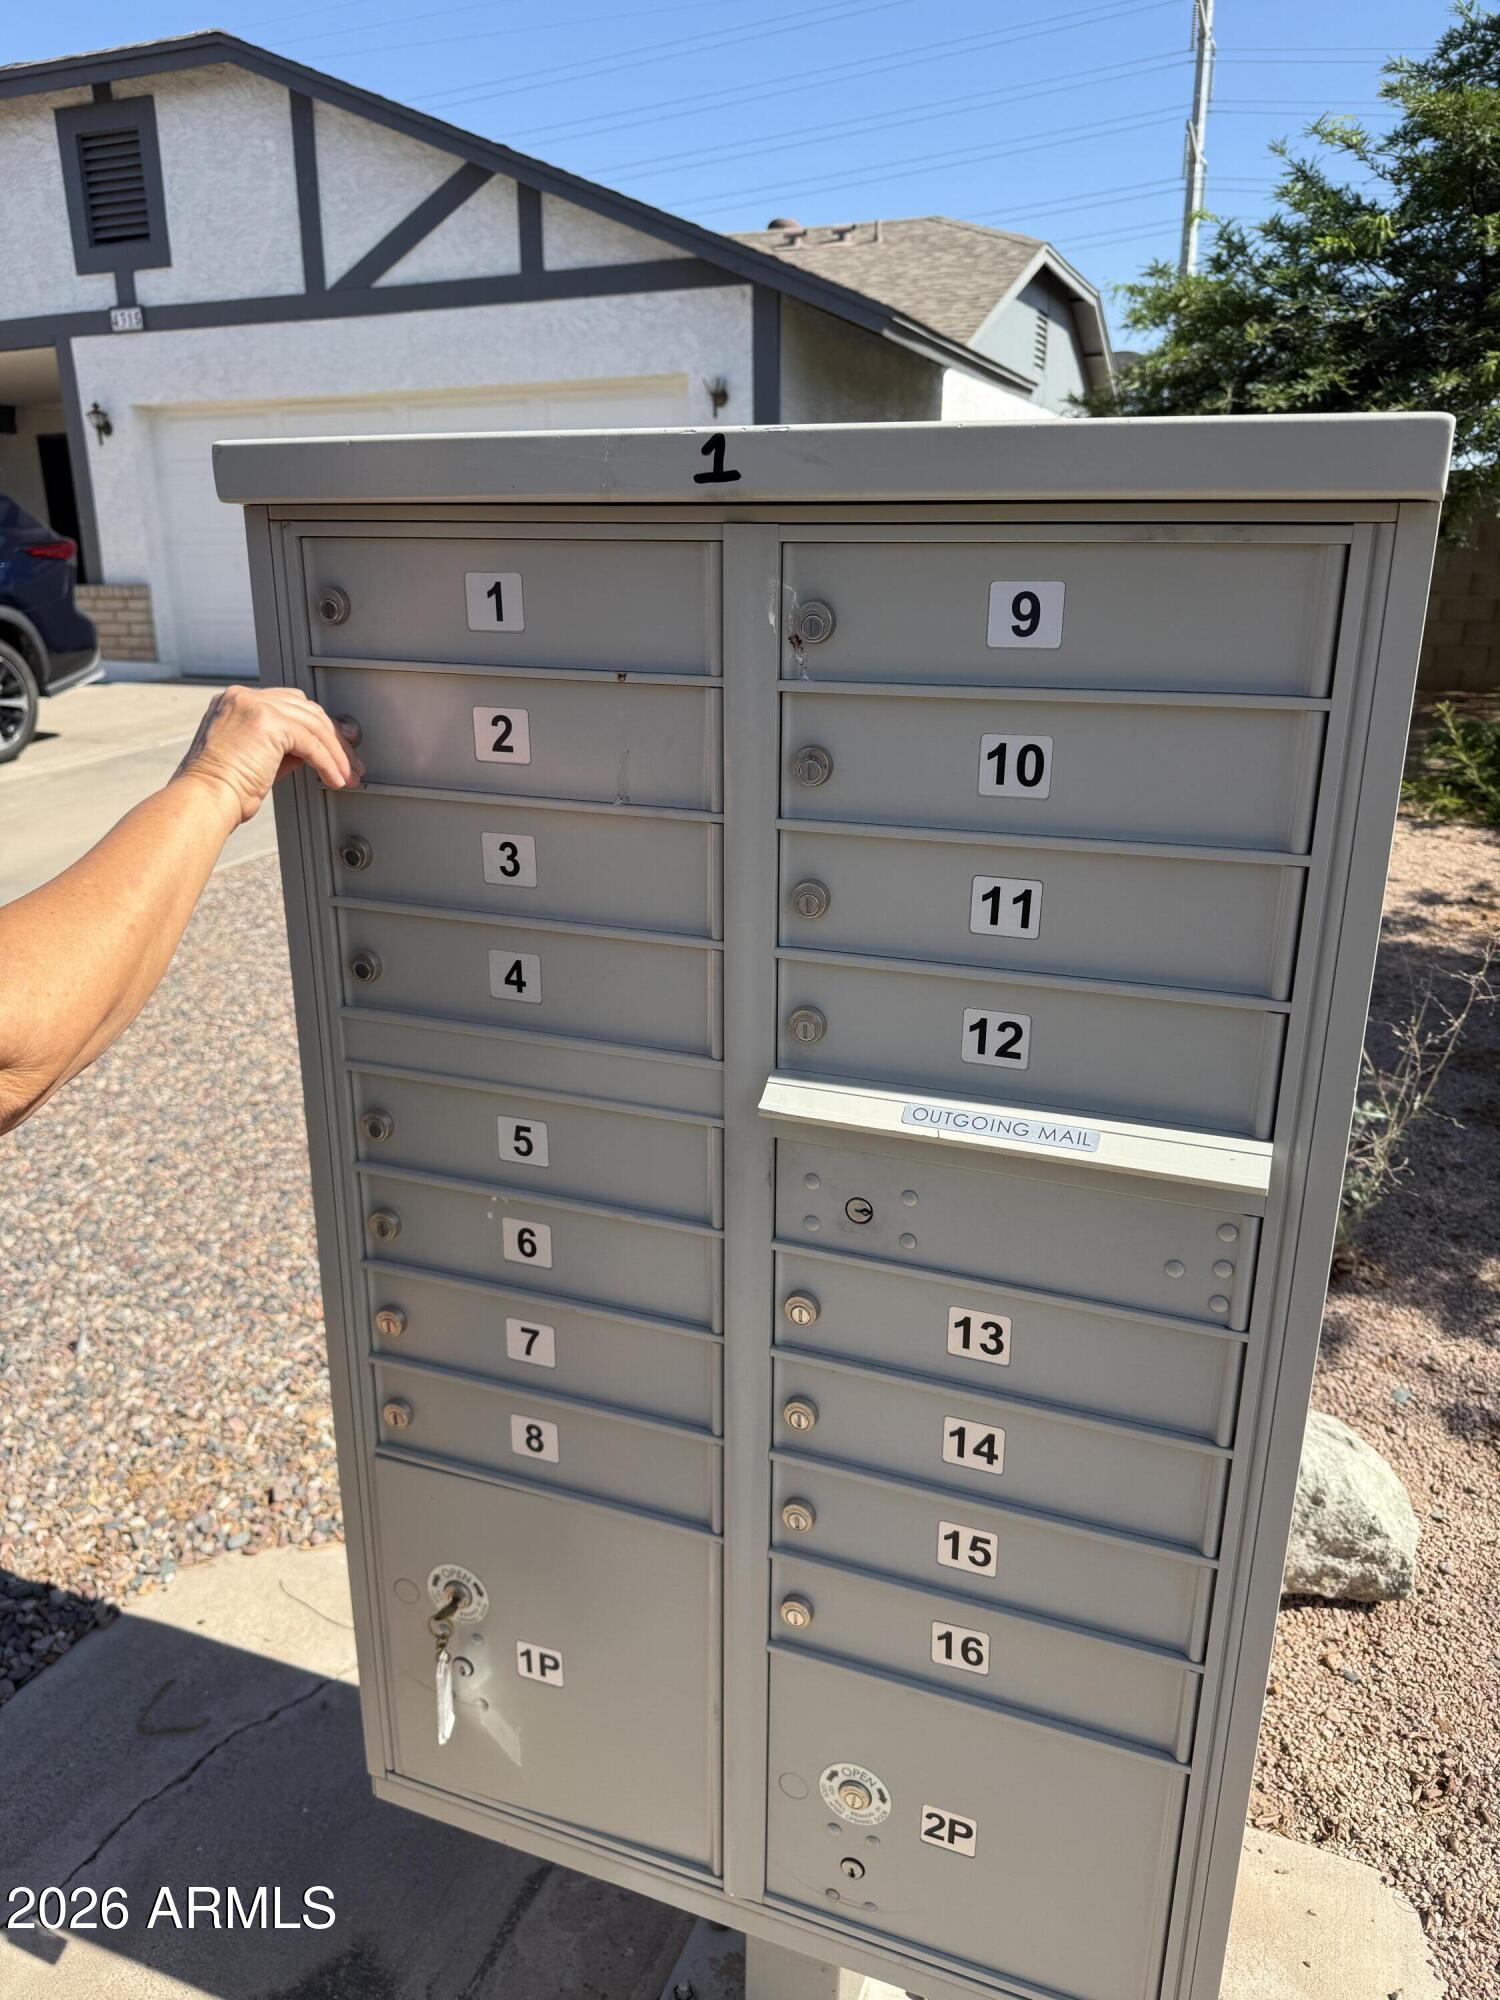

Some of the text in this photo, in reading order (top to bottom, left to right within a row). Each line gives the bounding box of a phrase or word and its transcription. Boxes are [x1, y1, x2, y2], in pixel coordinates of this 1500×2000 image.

[693, 432, 742, 484] 1
[486, 581, 504, 622] 1
[1011, 591, 1040, 637] 9
[491, 715, 514, 752] 2
[986, 742, 1045, 788] 10
[499, 842, 520, 877] 3
[981, 886, 1033, 929] 11
[504, 960, 527, 993] 4
[969, 1017, 1025, 1060] 12
[513, 1125, 534, 1156] 5
[912, 1107, 1091, 1147] OUTGOING MAIL
[518, 1228, 537, 1258] 6
[521, 1327, 540, 1356] 7
[955, 1317, 1005, 1356] 13
[525, 1424, 544, 1453] 8
[949, 1427, 999, 1465] 14
[944, 1530, 992, 1567] 15
[441, 1568, 471, 1583] OPEN
[520, 1648, 560, 1676] 1P
[937, 1631, 984, 1666] 16
[841, 1767, 877, 1787] OPEN
[924, 1812, 973, 1845] 2P
